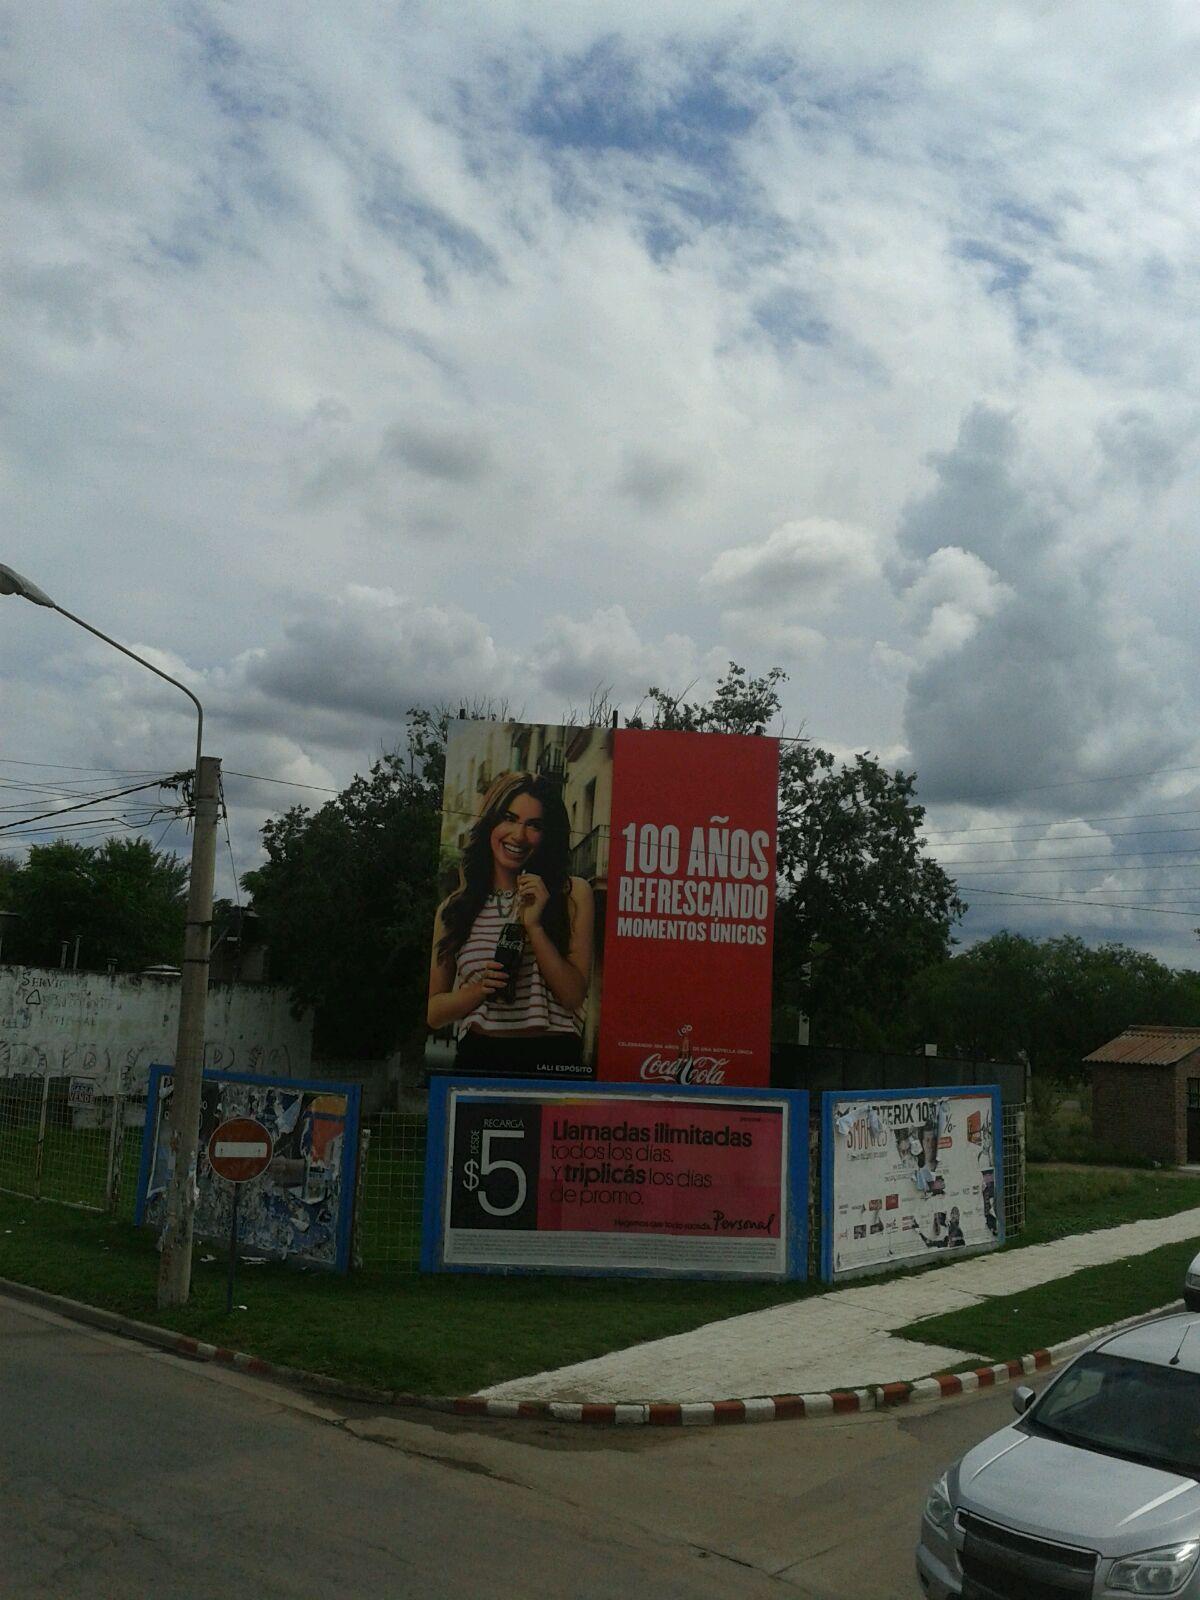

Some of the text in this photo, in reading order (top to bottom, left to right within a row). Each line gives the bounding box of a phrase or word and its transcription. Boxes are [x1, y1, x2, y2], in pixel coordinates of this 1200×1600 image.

[622, 815, 770, 881] 100 AÑOS
[618, 876, 769, 920] REFRESCANDO
[617, 917, 767, 945] MOMENTOS ÚNICOS
[536, 1063, 554, 1072] LALI
[483, 1118, 524, 1128] RECARGA
[553, 1120, 752, 1148] Llamadas ilimitadas
[470, 1129, 480, 1154] DESDE
[551, 1143, 605, 1160] todos
[608, 1142, 633, 1160] los
[551, 1166, 562, 1182] Y
[564, 1163, 646, 1187] triplicás
[649, 1168, 674, 1186] los
[550, 1184, 577, 1203] de
[712, 1210, 776, 1234] Personal
